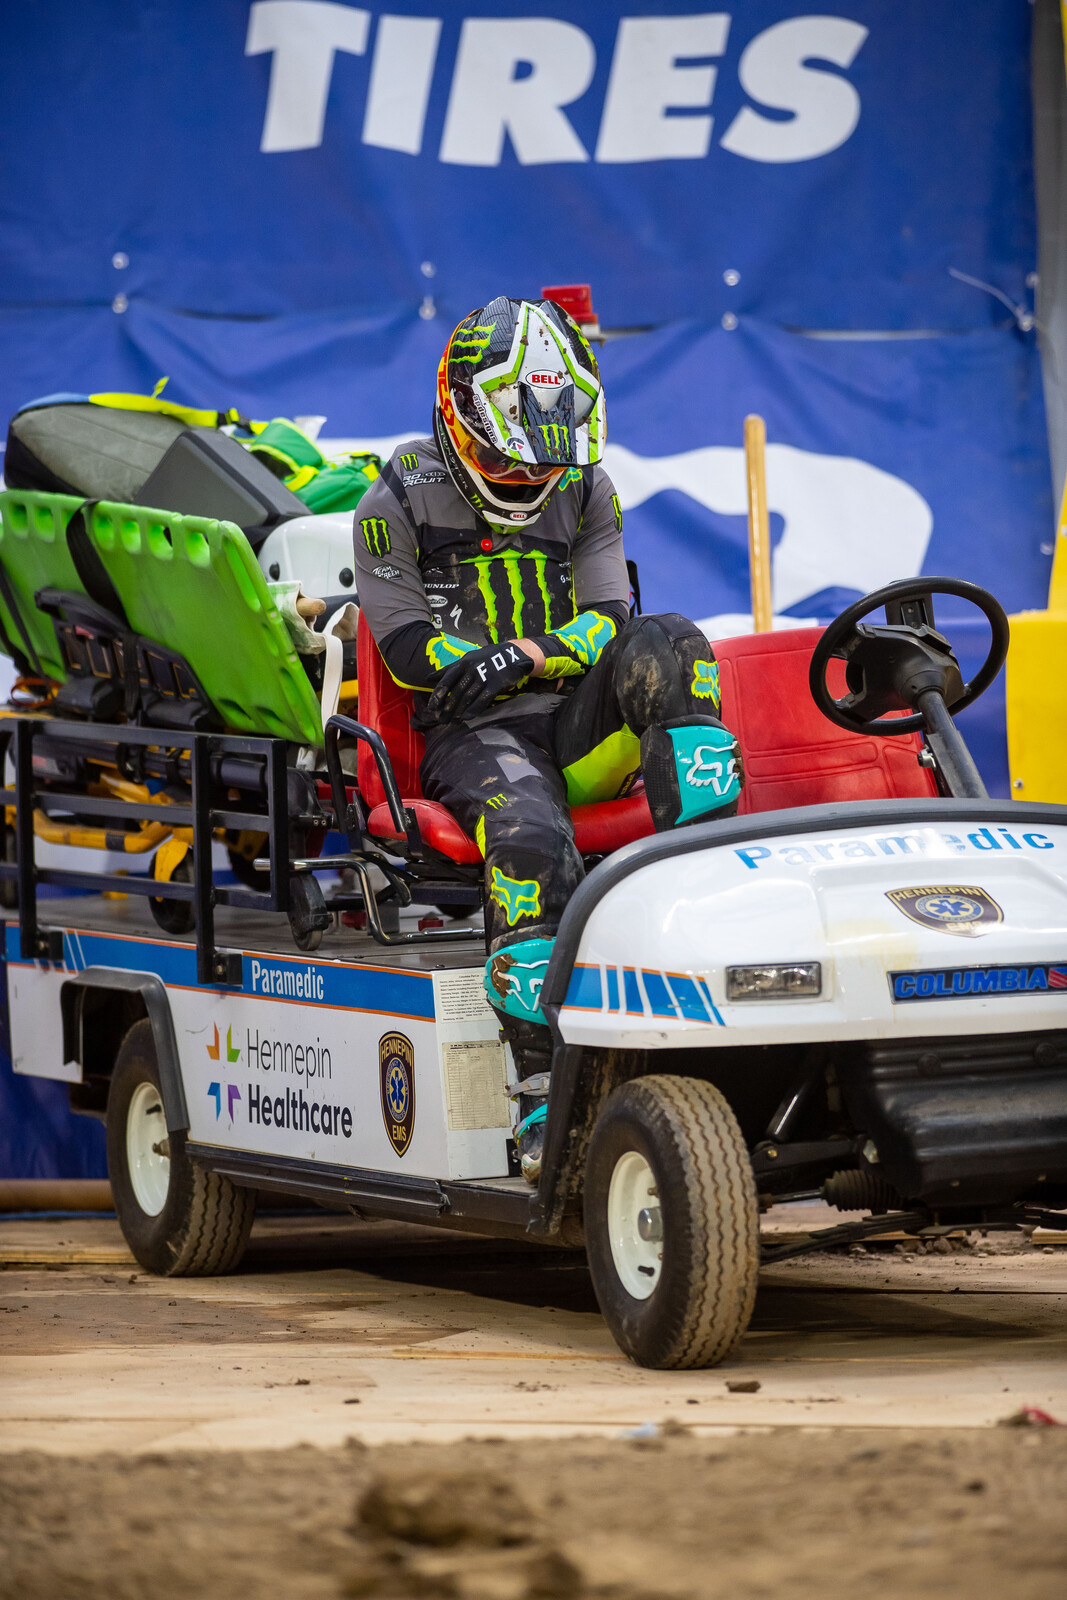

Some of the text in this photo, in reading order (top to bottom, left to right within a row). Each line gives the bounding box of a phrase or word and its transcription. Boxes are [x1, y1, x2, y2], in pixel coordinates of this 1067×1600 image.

[245, 0, 868, 167] TIRES
[531, 373, 561, 386] BELL
[402, 473, 422, 481] RO
[402, 477, 445, 488] RCUIT
[476, 646, 520, 682] FOX
[734, 827, 1056, 870] Paramedic
[891, 886, 983, 902] HENNEPIN
[250, 959, 325, 1001] Paramedic
[894, 967, 1048, 998] COLUMBIA
[247, 1027, 333, 1089] Hennepin
[380, 1038, 413, 1068] HENNEPIN
[248, 1083, 353, 1139] Healthcare
[392, 1124, 407, 1142] EMS
